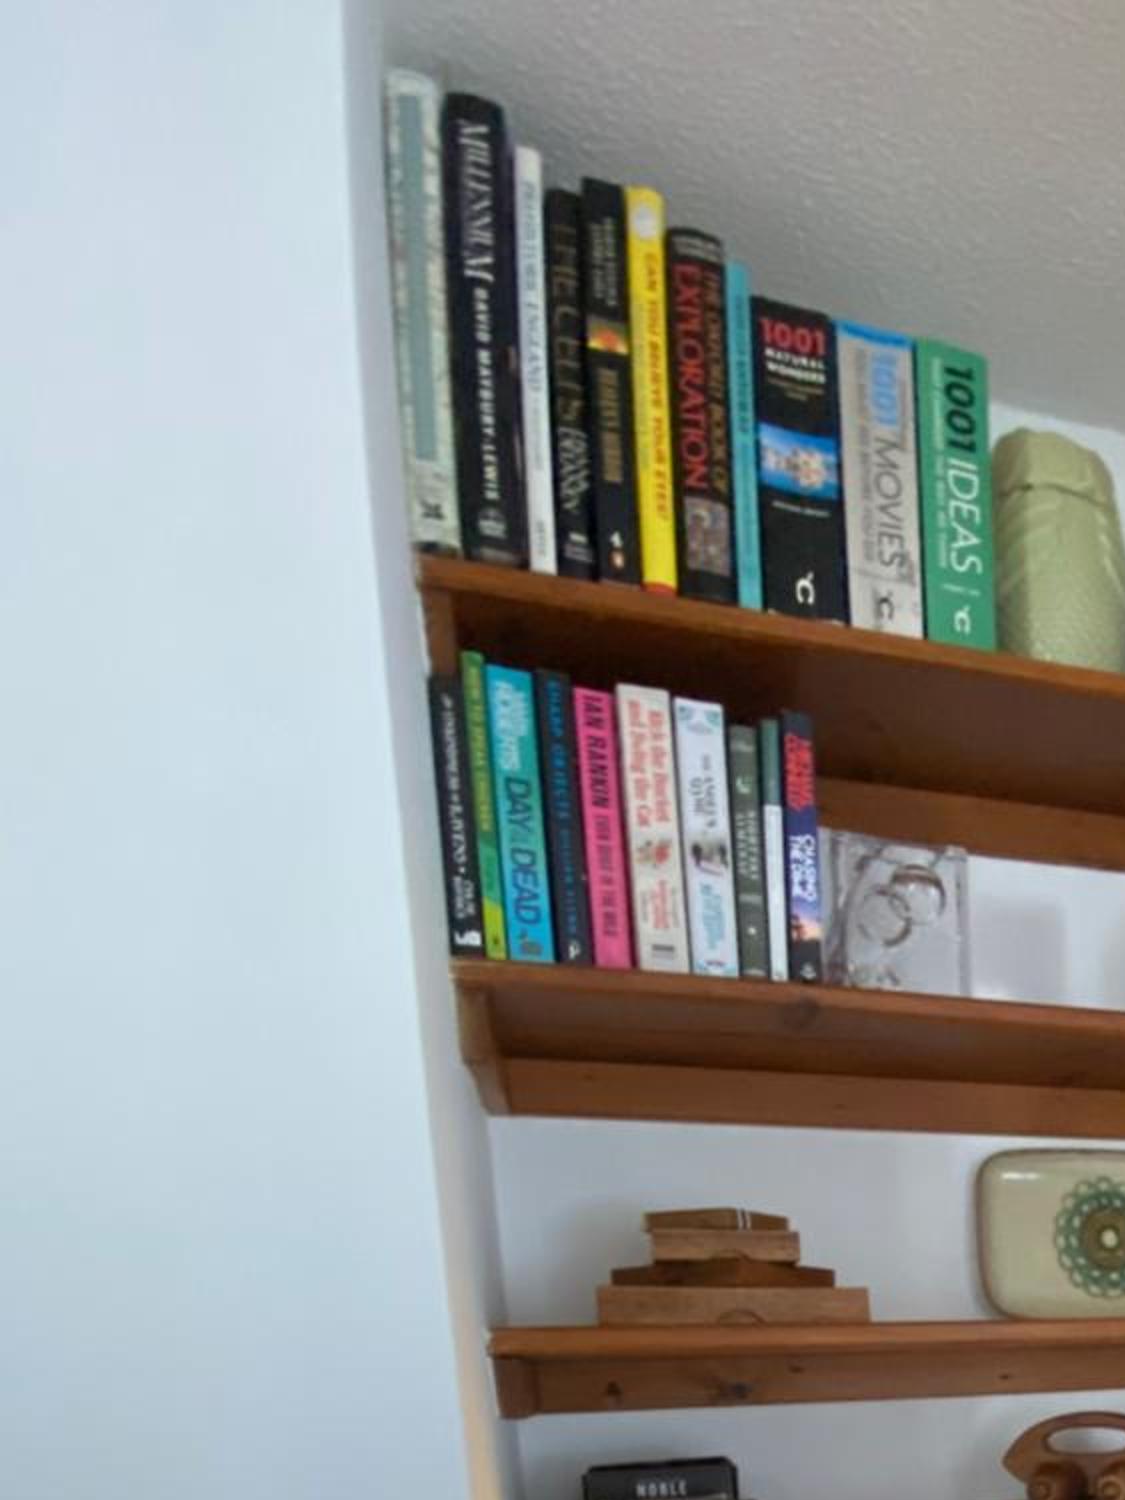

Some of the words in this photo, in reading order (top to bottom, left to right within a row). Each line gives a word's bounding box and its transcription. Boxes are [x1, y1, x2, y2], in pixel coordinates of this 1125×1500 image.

[458, 118, 496, 281] MILLENNIUM
[645, 252, 658, 291] CAN
[474, 287, 491, 343] DAVID
[647, 300, 661, 334] YOU
[759, 318, 826, 355] 1001
[554, 304, 583, 420] CELTS
[672, 264, 709, 488] EXPLORATION
[764, 347, 826, 370] NATURAL
[871, 351, 898, 425] 1001
[476, 348, 500, 499] MAYBURY-LEWIS
[944, 366, 976, 453] 1001
[874, 435, 906, 568] MOVIES
[948, 457, 983, 574] IDEAS
[582, 695, 604, 730] IAN
[504, 777, 532, 832] DAY
[587, 734, 609, 808] RANKIN
[511, 847, 543, 925] DEAD
[636, 1479, 688, 1498] NOBLE
